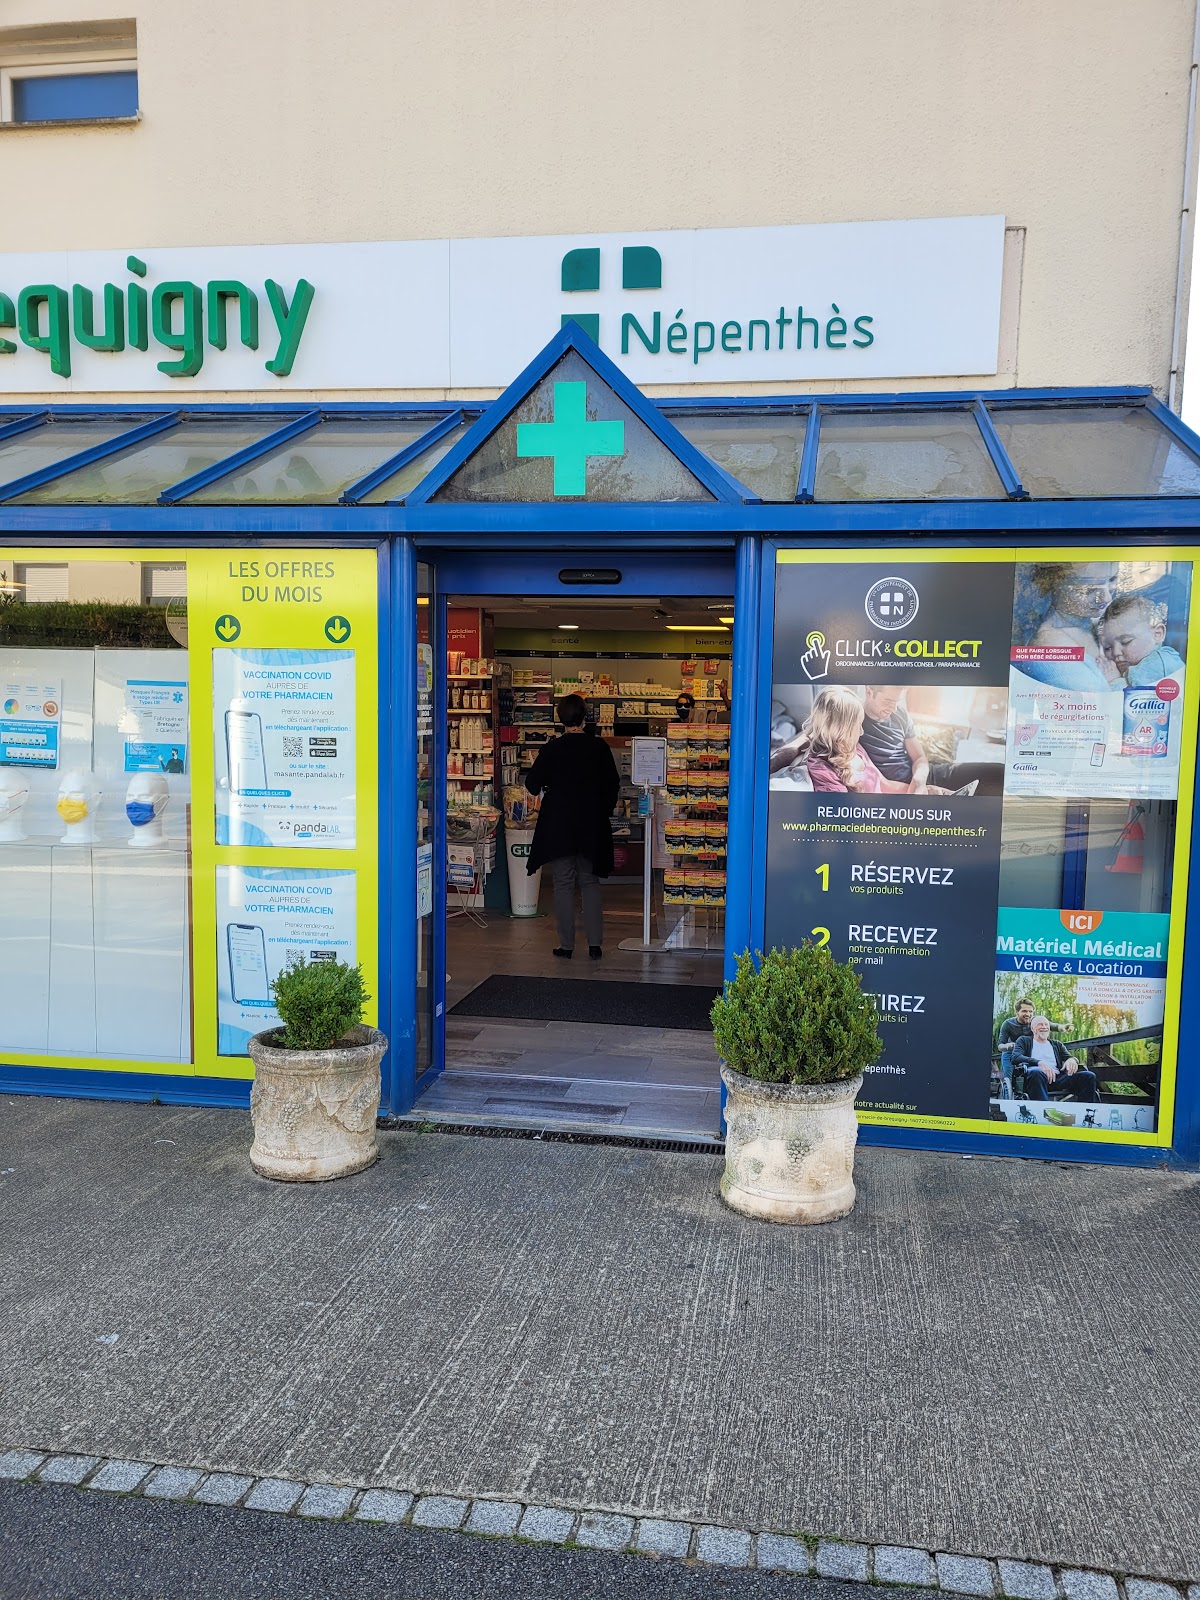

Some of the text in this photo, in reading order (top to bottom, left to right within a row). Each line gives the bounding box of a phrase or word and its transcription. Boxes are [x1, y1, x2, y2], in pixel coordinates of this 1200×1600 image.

[620, 303, 875, 365] Népenthès
[229, 562, 335, 578] LES OFFRES
[242, 586, 323, 602] DU MOIS
[835, 639, 982, 658] CLICK & COLLECT
[243, 671, 332, 680] VACCINATION COVID
[274, 692, 333, 700] PHARMACIEN
[1053, 702, 1064, 710] 3x
[1129, 699, 1165, 710] Gallia
[1157, 744, 1164, 752] 2
[817, 806, 952, 821] REJOIGNEZ NOUS SUR
[782, 822, 987, 837] www.pharmaciedebrequigny.nepenthes.fr
[815, 863, 830, 892] 1
[851, 860, 954, 886] RÉSERVEZ
[246, 885, 332, 895] VACCINATION COVID
[866, 885, 904, 895] produits
[245, 904, 334, 915] VOTRE PHARMACIEN
[1069, 915, 1092, 930] ICI
[811, 926, 830, 948] 2
[848, 924, 938, 945] RECEVEZ
[848, 945, 930, 956] notre confirmation
[996, 936, 1162, 959] Matériel Médical
[865, 956, 884, 965] mail
[1014, 957, 1143, 975] Vente & Location
[898, 1014, 908, 1023] ici
[863, 1064, 906, 1075] épenthès
